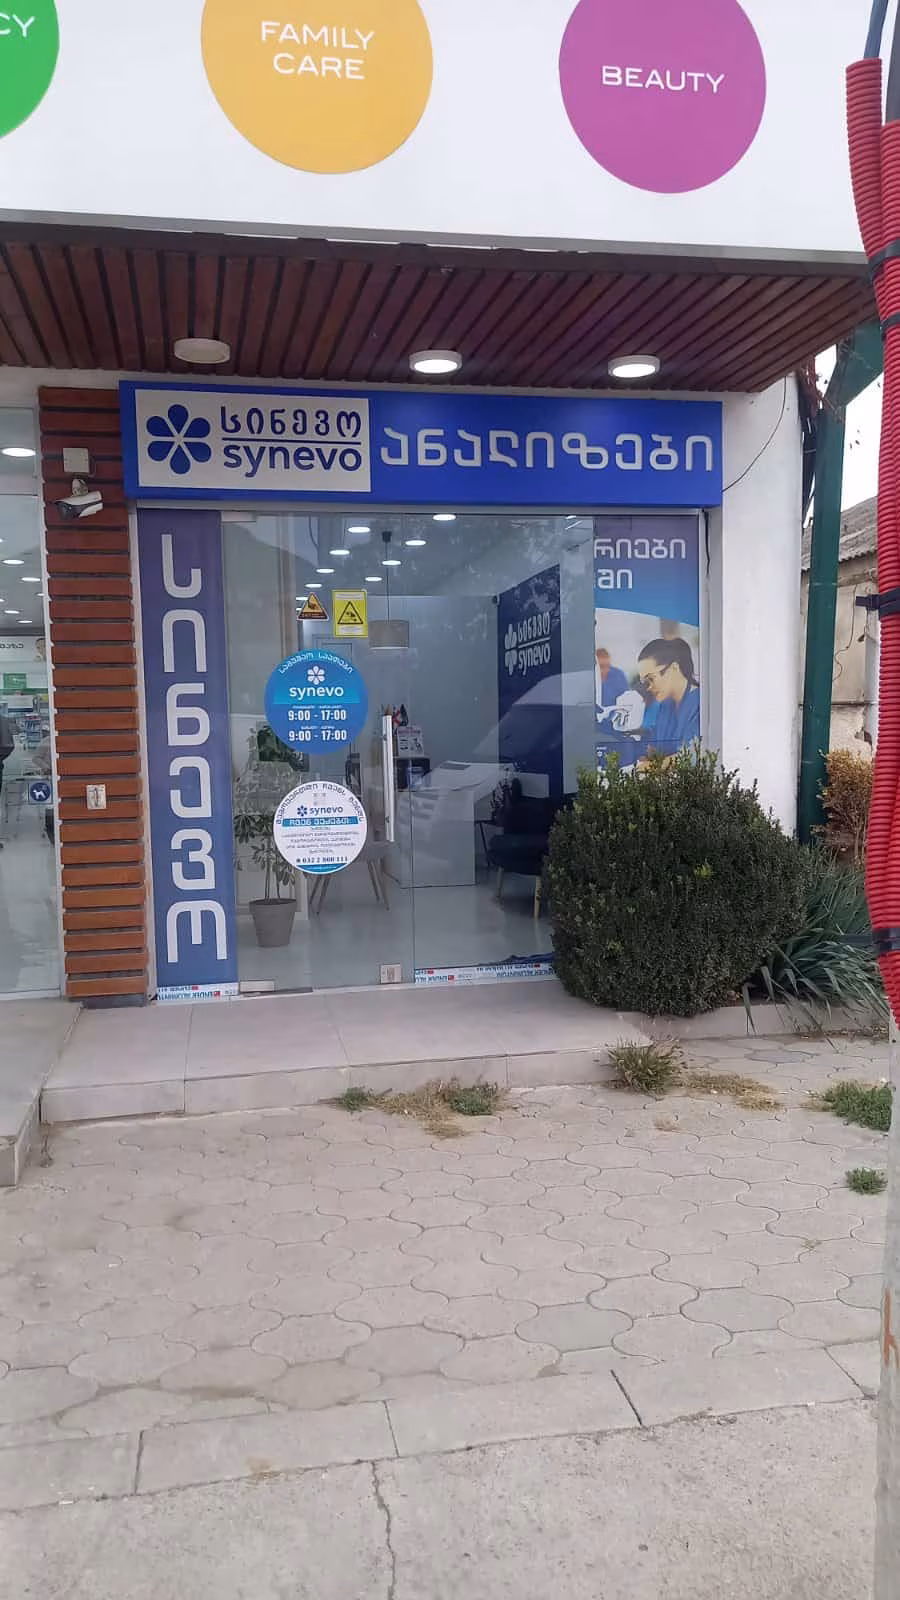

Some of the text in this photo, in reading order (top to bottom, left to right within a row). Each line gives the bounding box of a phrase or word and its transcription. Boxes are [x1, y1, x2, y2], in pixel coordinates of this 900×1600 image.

[260, 20, 375, 50] FAMILY
[272, 54, 366, 80] CARE
[601, 65, 725, 94] BEAUTY
[220, 405, 362, 439] სინევო
[223, 441, 362, 478] synevo
[380, 427, 714, 473] ანალიზები
[518, 643, 551, 676] synevo
[289, 686, 344, 700] synevo
[288, 709, 311, 721] 9:00
[321, 709, 347, 721] 17:00
[161, 533, 228, 963] სინევო
[288, 730, 311, 741] 9:00
[321, 730, 347, 741] 17:00
[309, 806, 344, 816] synevo
